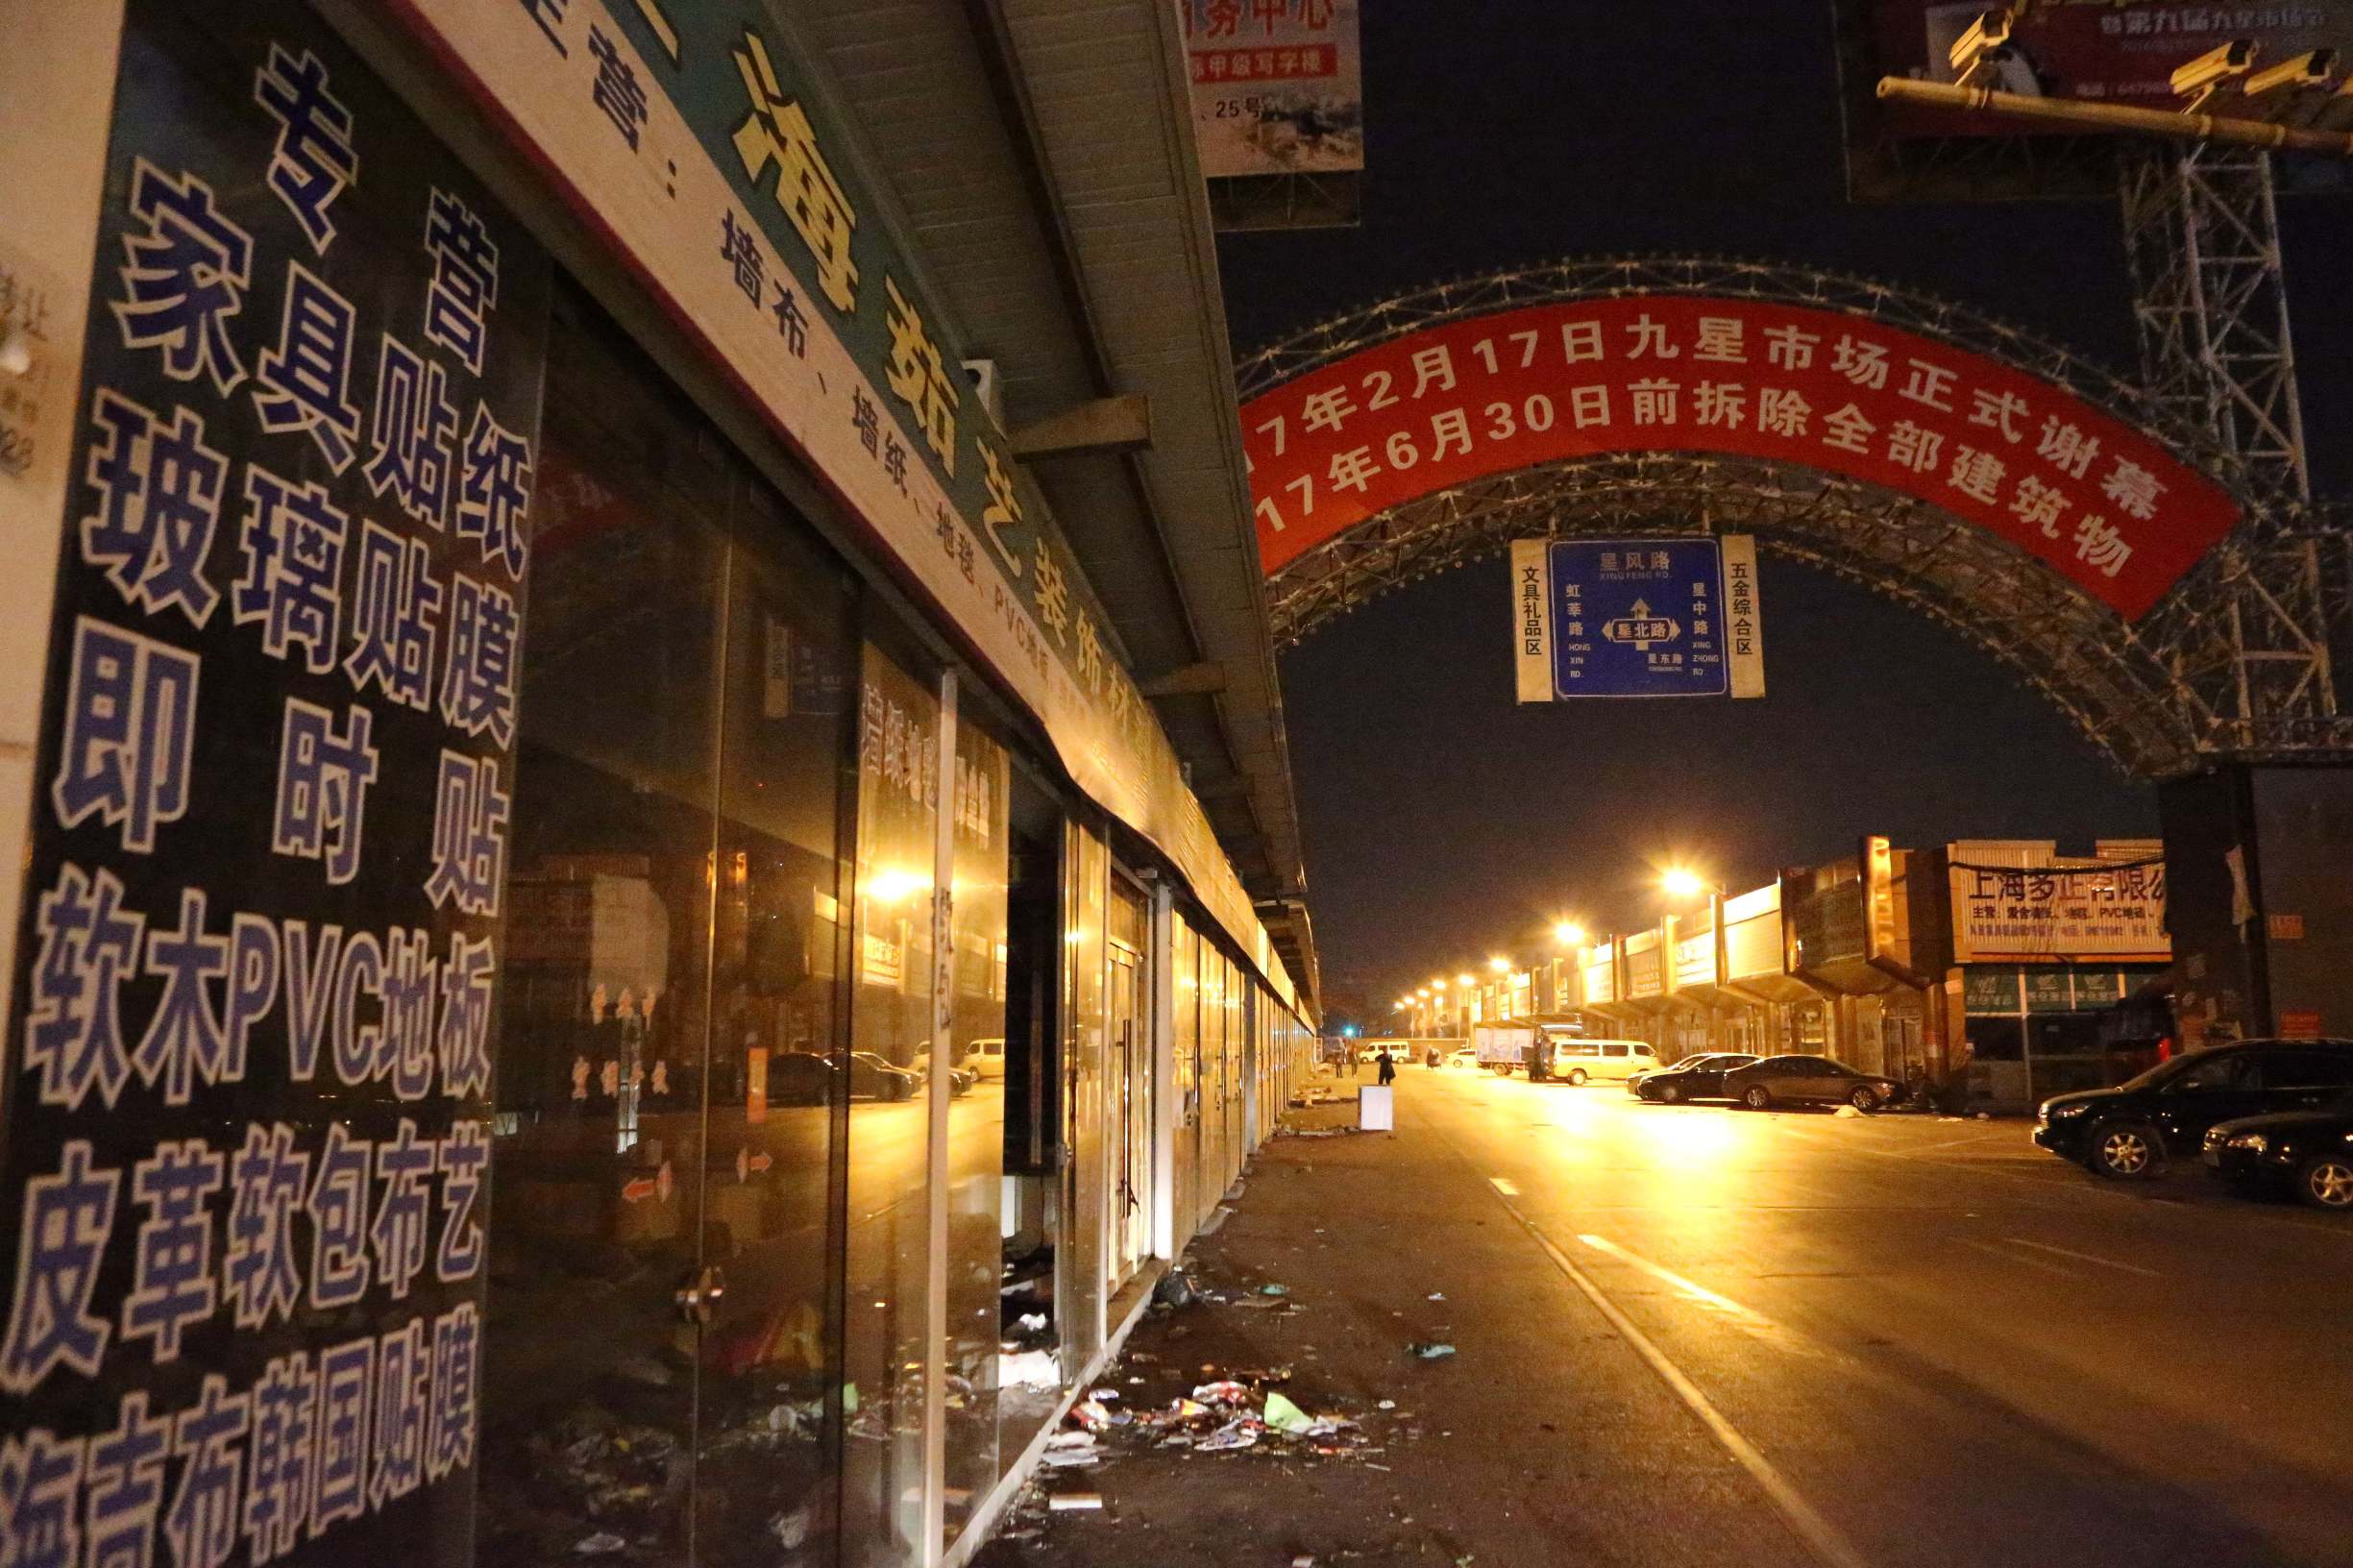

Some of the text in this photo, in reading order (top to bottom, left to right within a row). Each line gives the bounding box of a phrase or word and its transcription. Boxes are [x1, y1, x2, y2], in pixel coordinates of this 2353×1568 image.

[1184, 0, 1335, 39] 务中心
[1244, 313, 2169, 521] 7年2月17日九星市场正式谢幕
[1255, 377, 2134, 578] 17年6月30日前拆除全部建筑物
[81, 386, 520, 750] 玻璃贴膜
[1522, 566, 1542, 655] 文具礼品区
[1616, 624, 1667, 639] 星北路
[1731, 563, 1753, 655] 五金综合区
[1570, 656, 1583, 665] XIN
[52, 614, 511, 918] 即时贴
[0, 1117, 489, 1396] 皮革软包布艺
